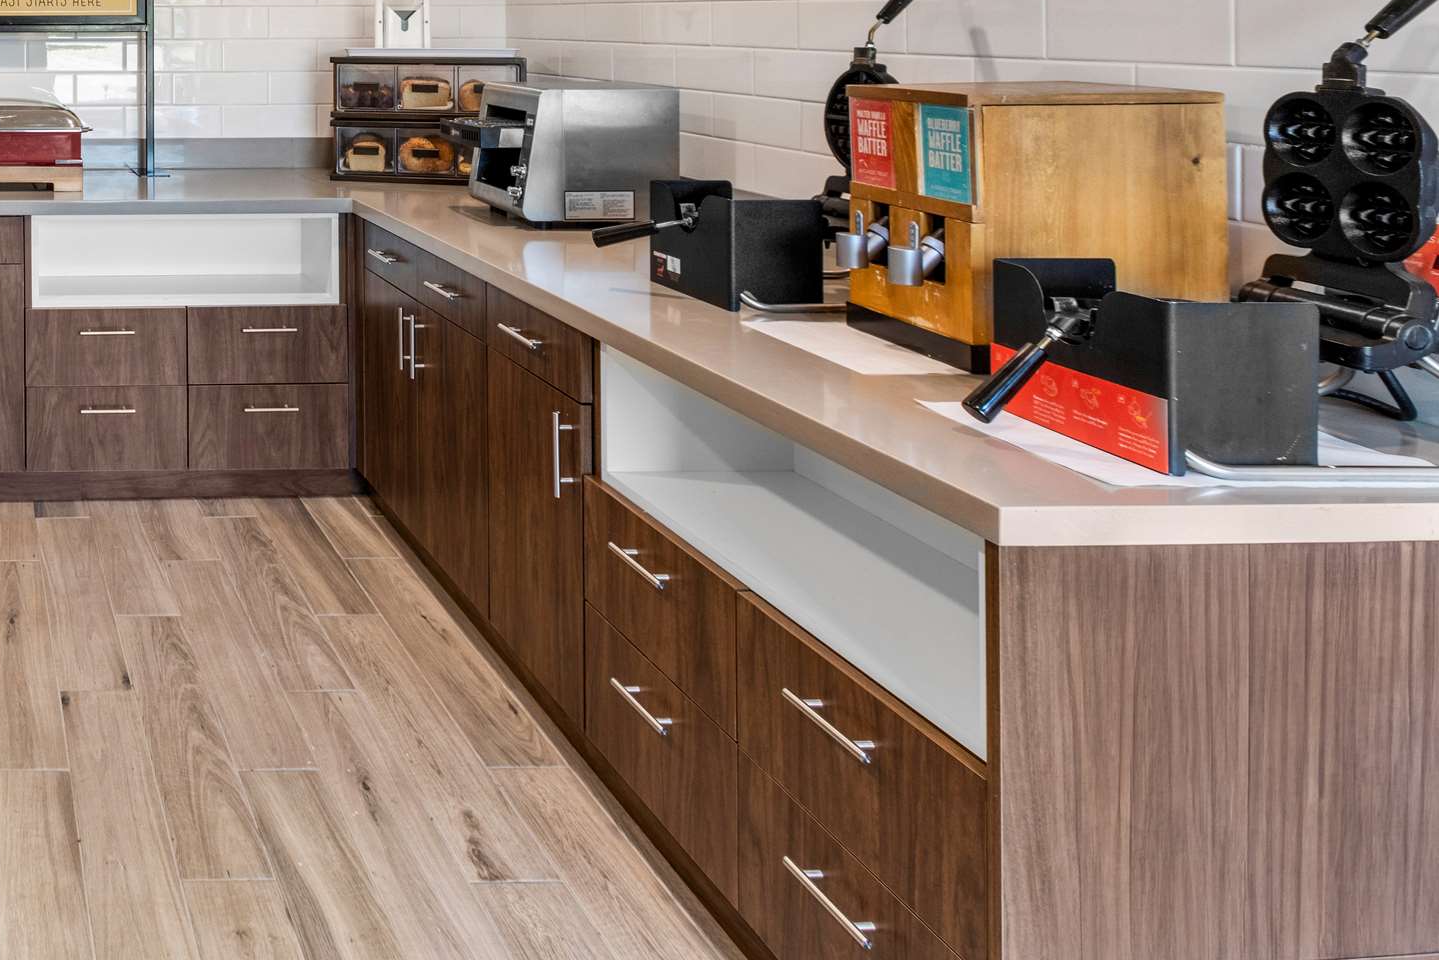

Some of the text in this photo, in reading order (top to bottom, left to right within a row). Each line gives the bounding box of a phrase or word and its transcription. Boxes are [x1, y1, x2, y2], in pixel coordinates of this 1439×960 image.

[857, 118, 887, 138] WAFFLE
[857, 136, 888, 157] BATTER
[927, 129, 962, 153] WAFFLE
[928, 149, 962, 172] BATTER
